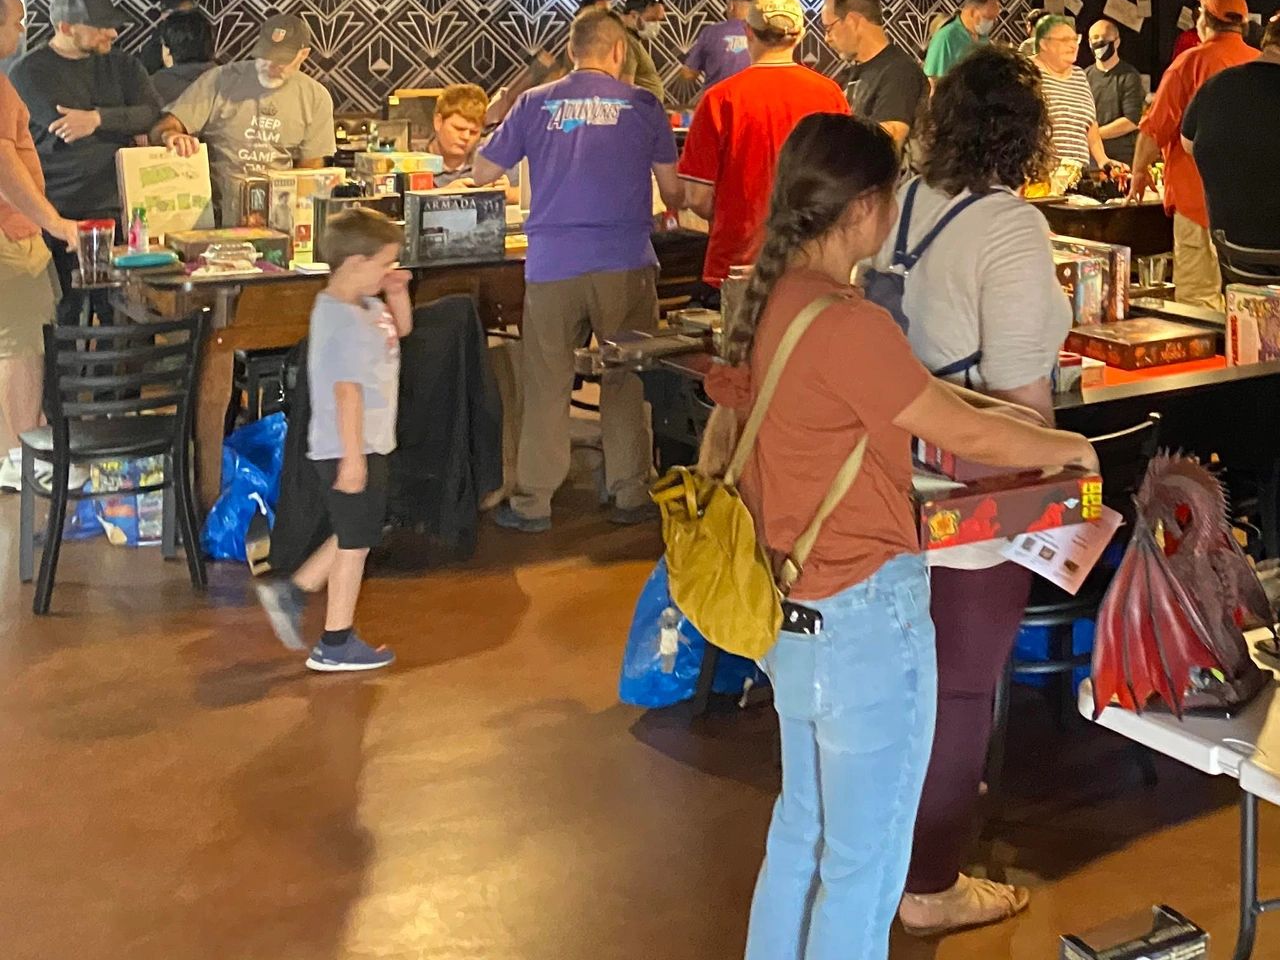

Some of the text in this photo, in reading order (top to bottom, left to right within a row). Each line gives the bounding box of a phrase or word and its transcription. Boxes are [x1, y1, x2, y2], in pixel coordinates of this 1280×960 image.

[251, 115, 281, 130] KEEP
[244, 128, 281, 143] CALM
[424, 199, 476, 211] ARMADA
